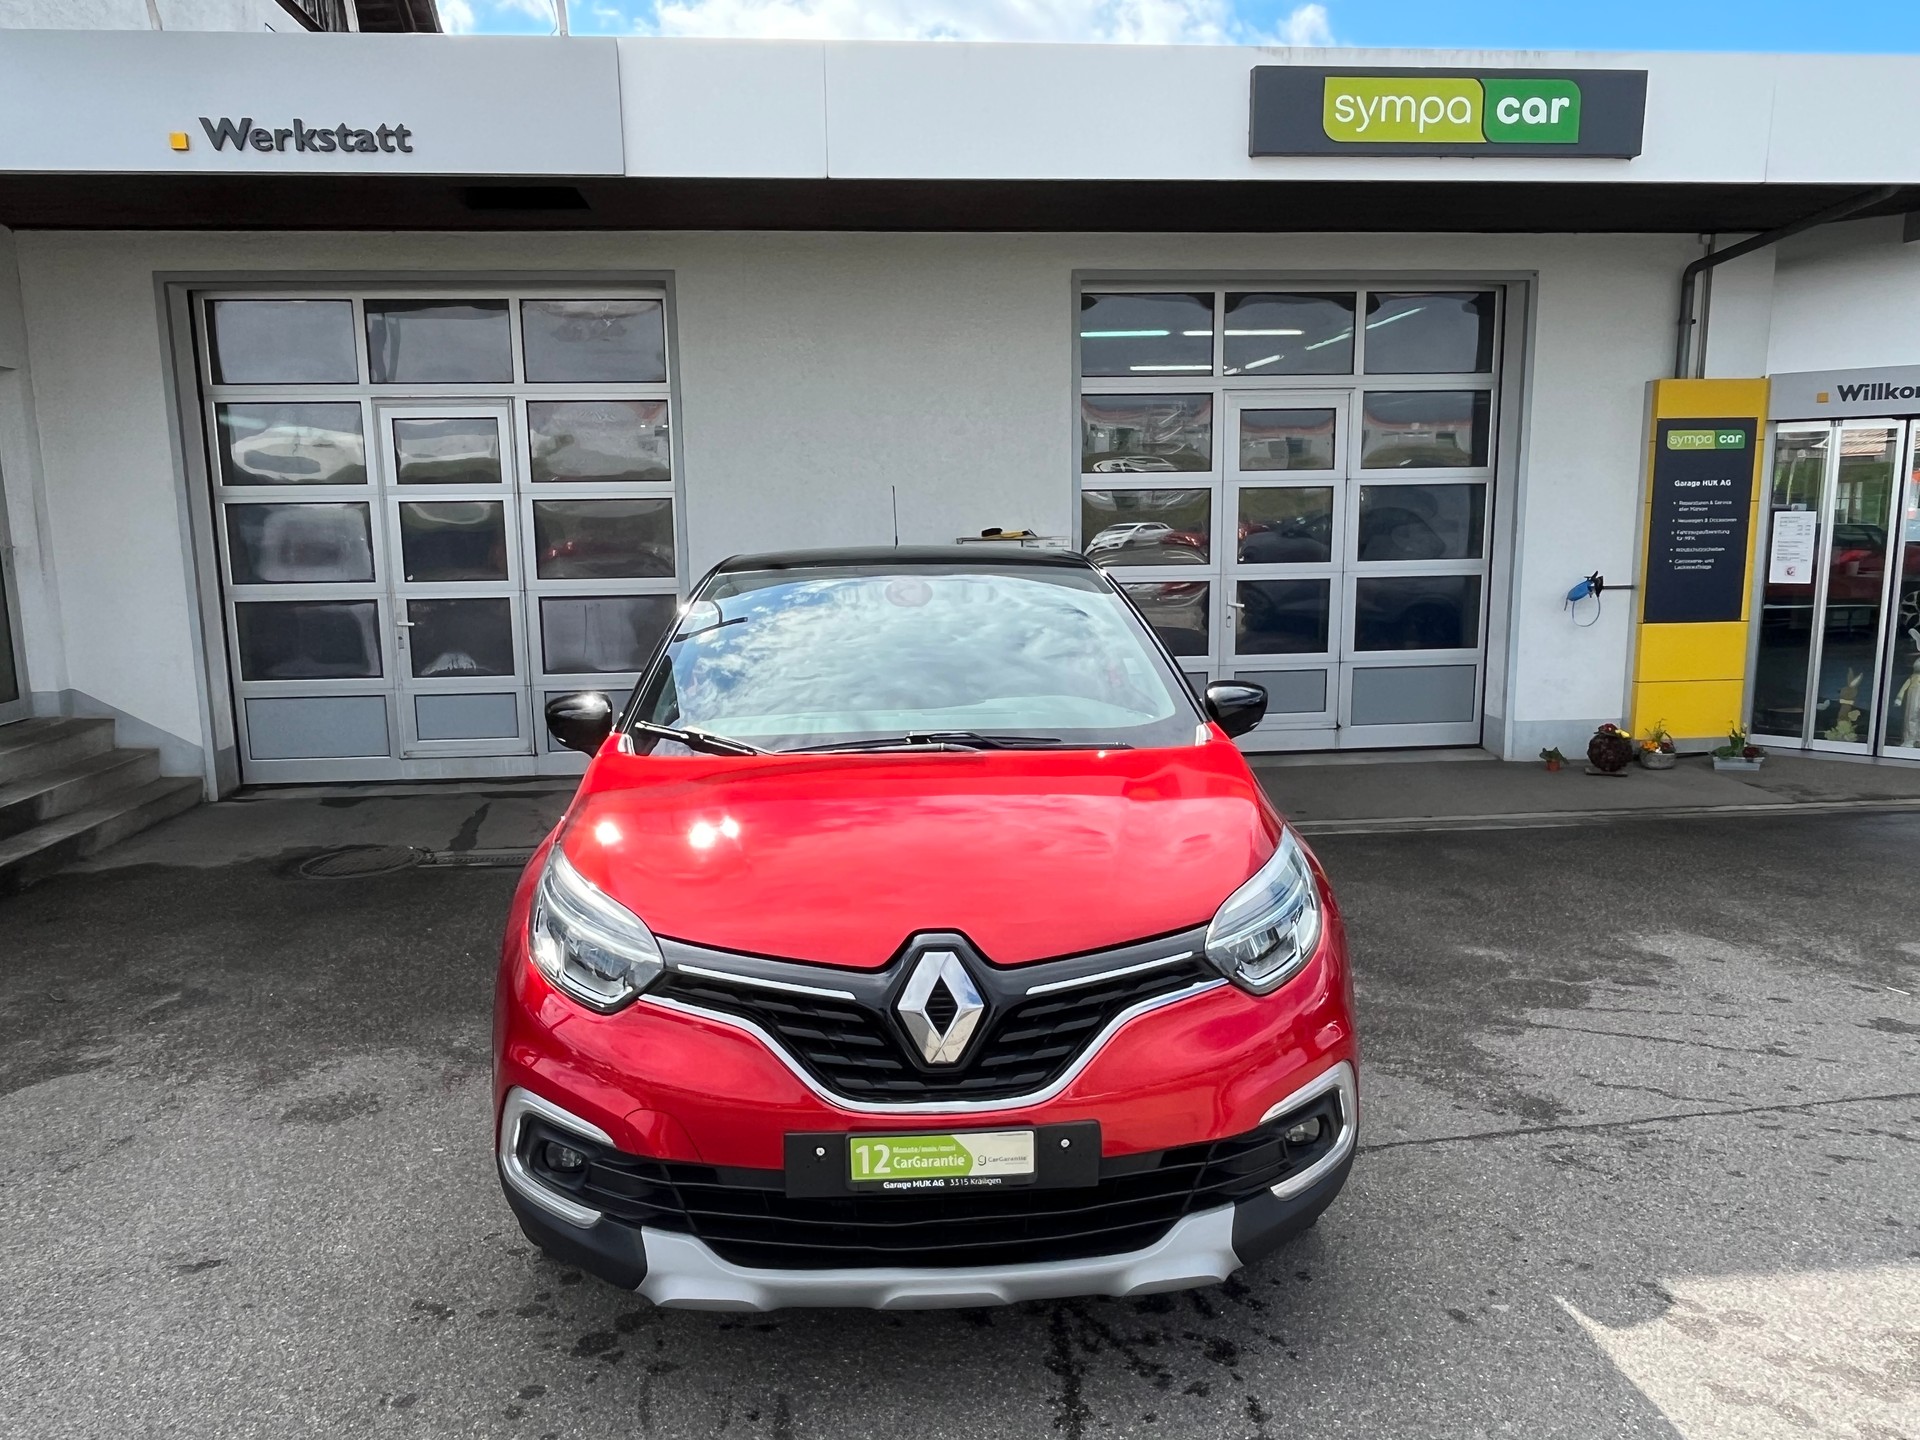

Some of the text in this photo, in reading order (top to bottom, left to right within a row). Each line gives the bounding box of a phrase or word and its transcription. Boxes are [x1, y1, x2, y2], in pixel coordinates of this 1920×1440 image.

[1335, 94, 1570, 133] sympa car
[198, 117, 413, 153] Werkstatt
[1669, 434, 1743, 447] sympa car
[1674, 480, 1701, 488] Garage
[1720, 479, 1732, 487] AG
[855, 1144, 891, 1174] 12
[893, 1153, 966, 1169] CarGarantie
[883, 1181, 912, 1190] Garage
[932, 1179, 945, 1187] AG
